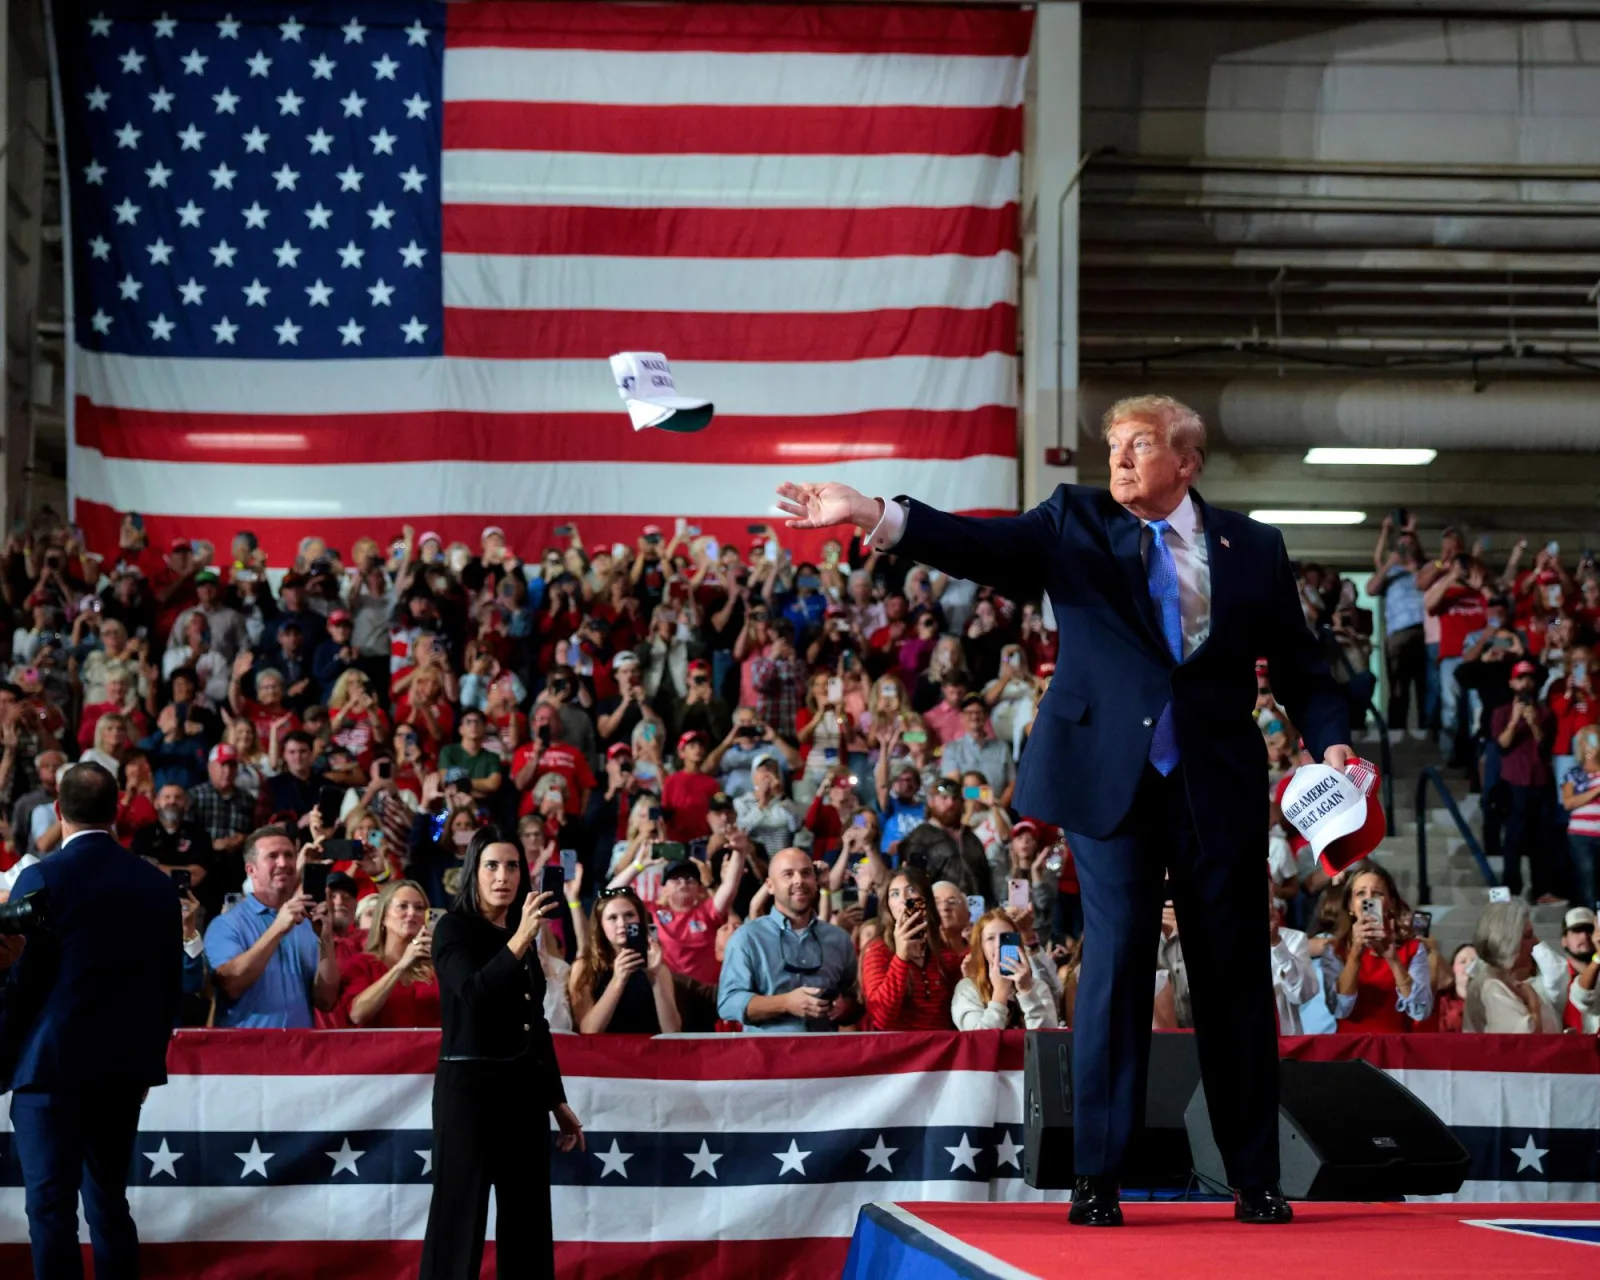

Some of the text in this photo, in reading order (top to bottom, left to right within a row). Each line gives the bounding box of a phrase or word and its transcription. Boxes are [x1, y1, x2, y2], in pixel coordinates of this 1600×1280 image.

[651, 375, 675, 389] GRE
[1284, 775, 1339, 821] MAKE AMERICA
[1316, 790, 1345, 818] AGAIN
